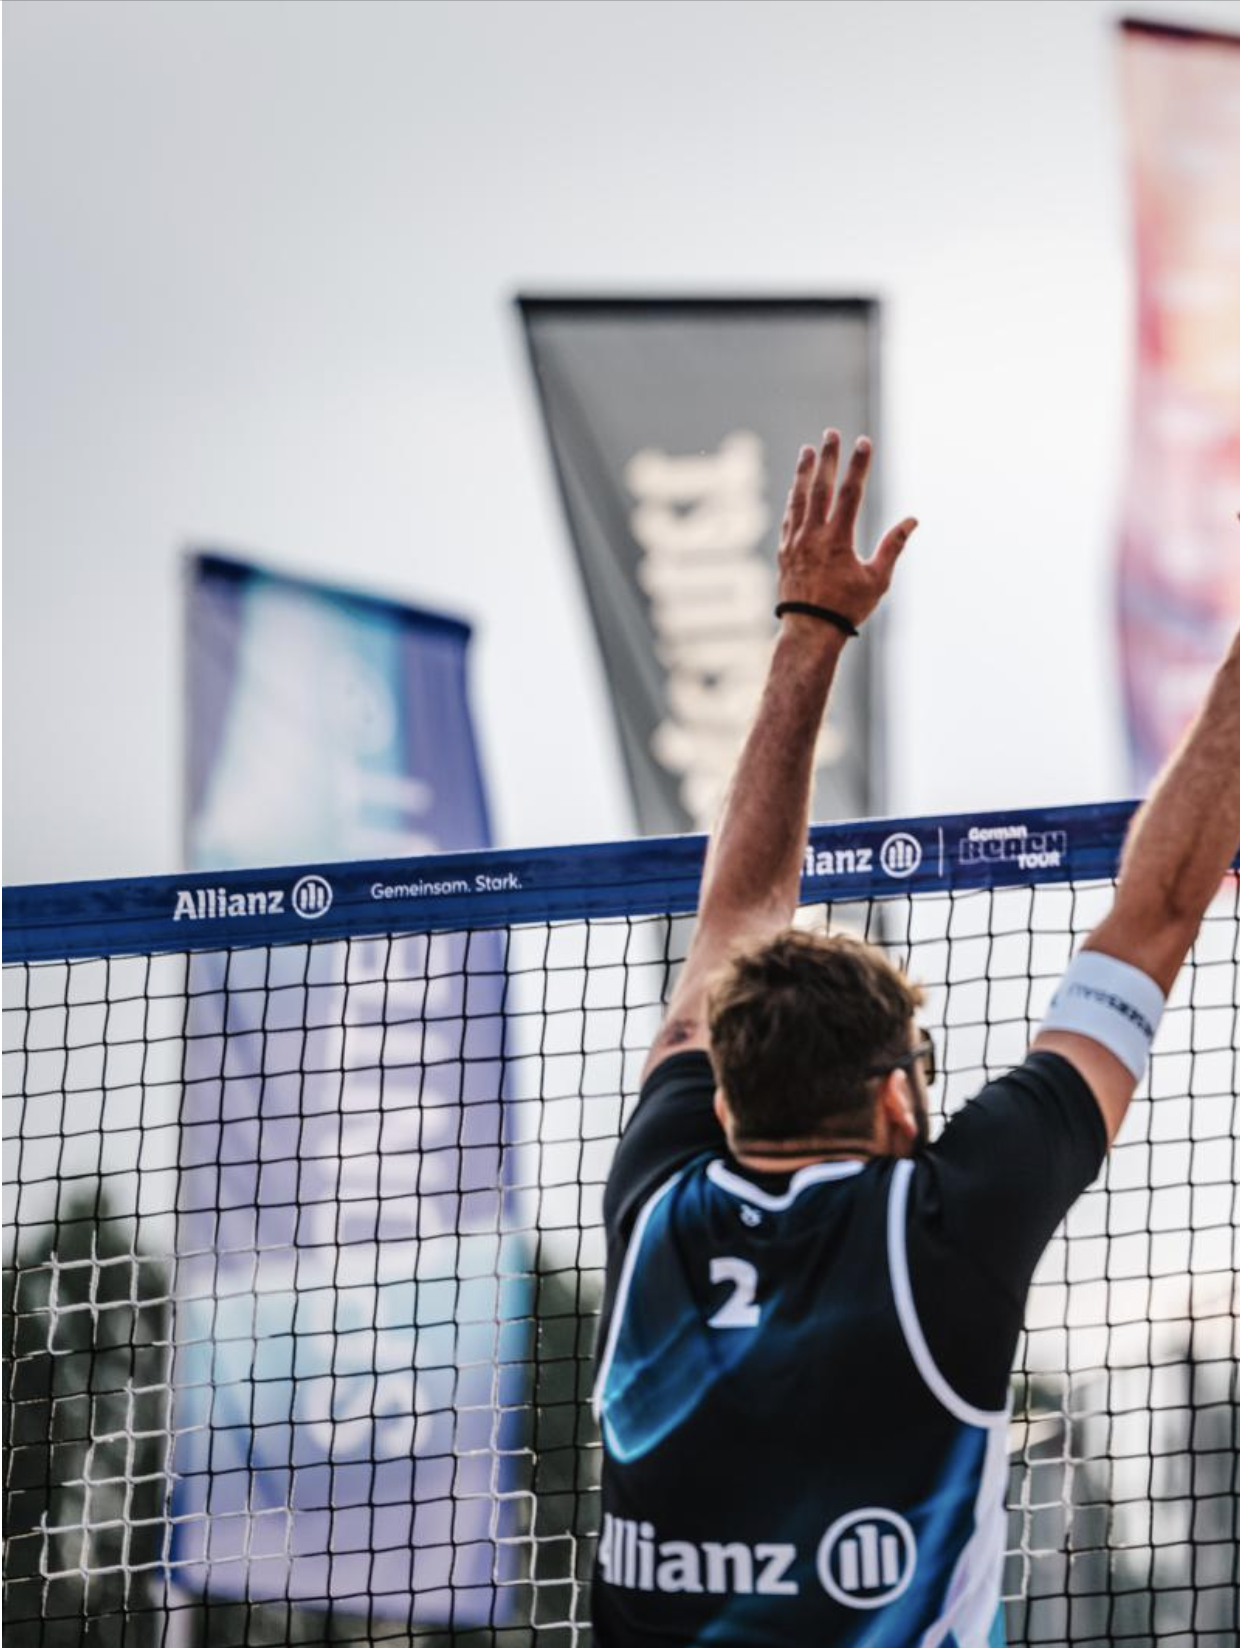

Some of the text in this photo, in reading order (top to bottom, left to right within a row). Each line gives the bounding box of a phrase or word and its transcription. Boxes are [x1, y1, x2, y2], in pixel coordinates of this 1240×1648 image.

[968, 825, 1028, 842] German
[1018, 851, 1061, 870] TOUR
[370, 873, 523, 900] Gemeinsam. Stark.
[173, 889, 285, 921] Allianz
[707, 1257, 760, 1329] 2
